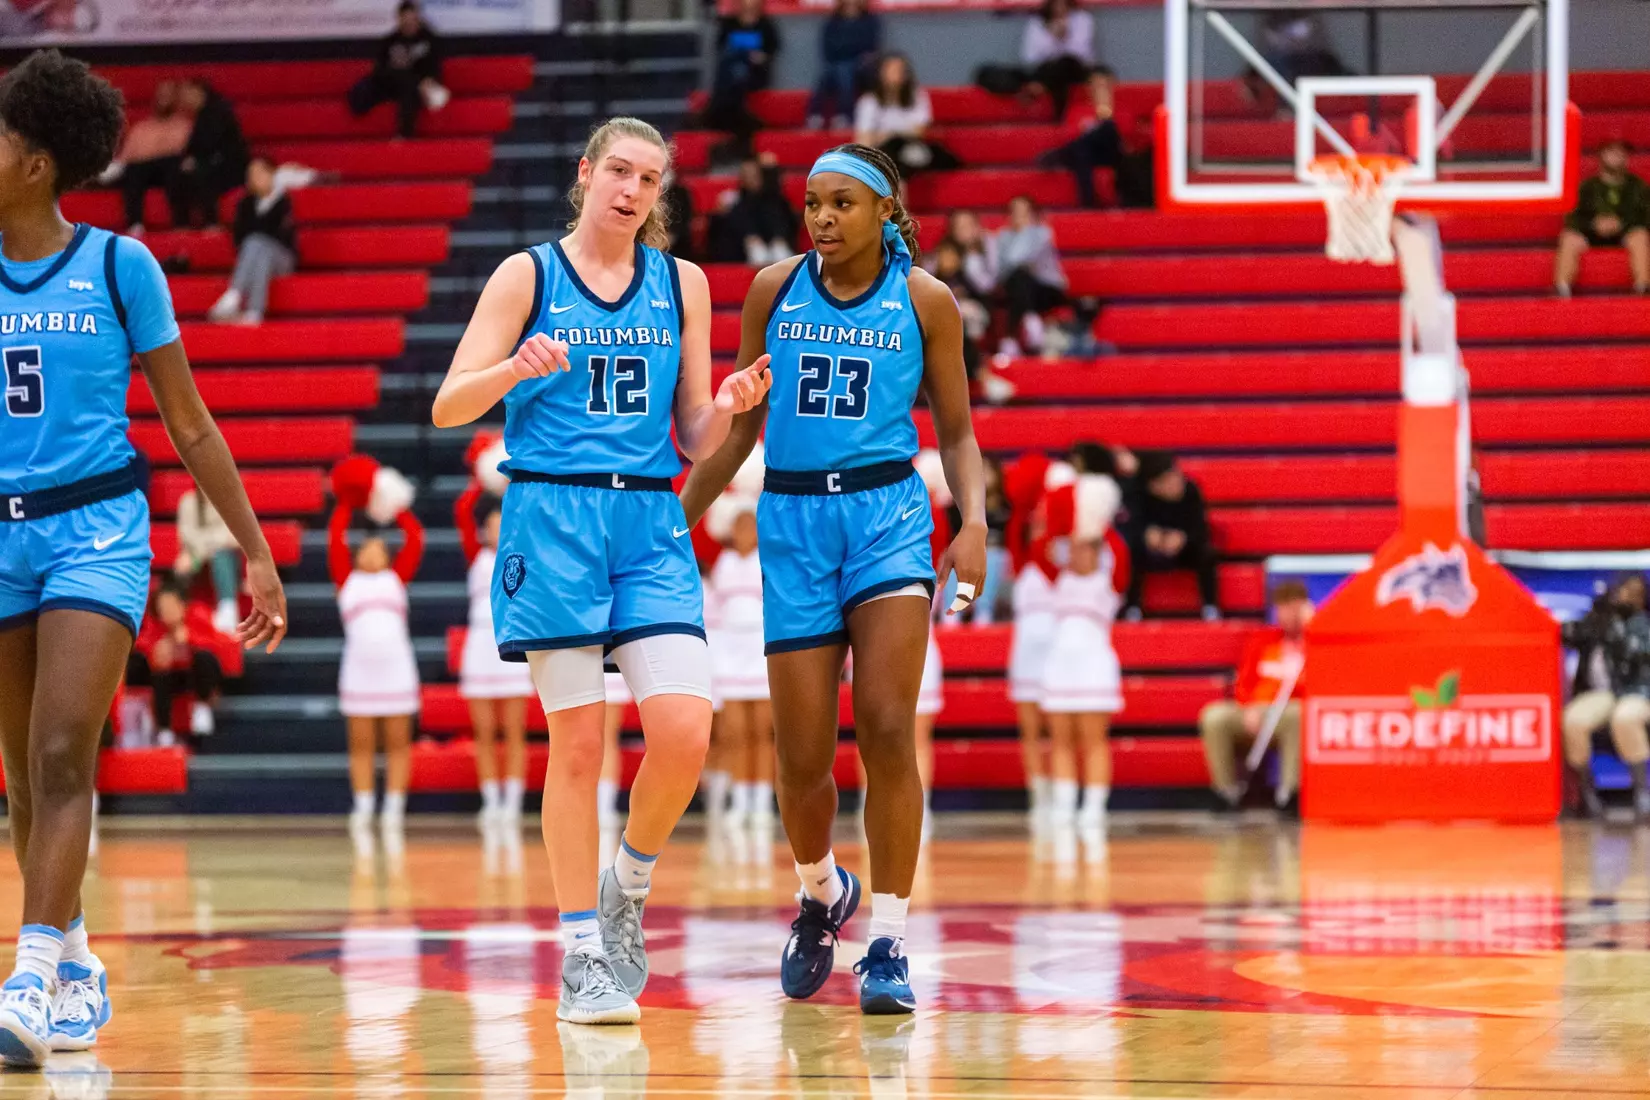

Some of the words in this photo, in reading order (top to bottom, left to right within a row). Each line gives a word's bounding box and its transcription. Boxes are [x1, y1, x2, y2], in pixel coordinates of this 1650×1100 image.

[553, 327, 673, 347] COLUMBIA
[778, 322, 902, 351] COLUMBIA
[3, 345, 44, 418] 5
[586, 355, 649, 416] 12
[796, 352, 873, 420] 23
[827, 473, 841, 493] C
[9, 496, 25, 519] C
[1320, 709, 1539, 748] REDEFINE
